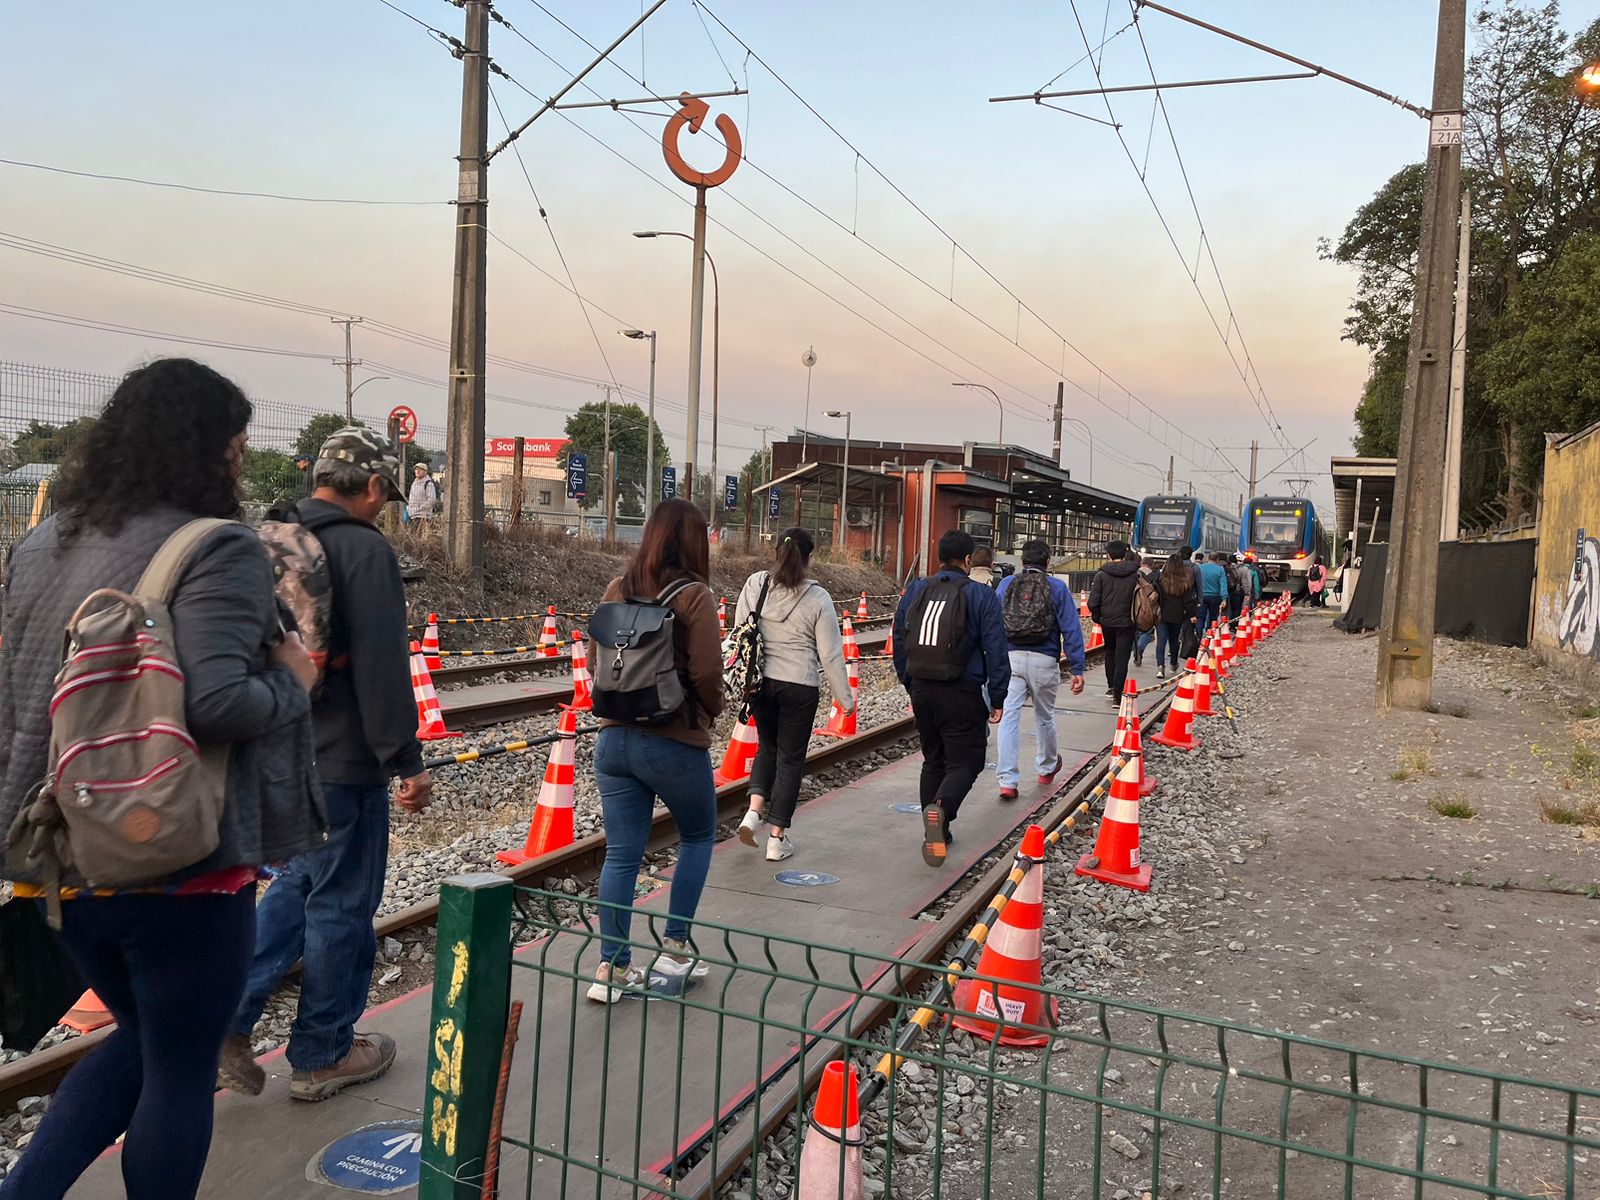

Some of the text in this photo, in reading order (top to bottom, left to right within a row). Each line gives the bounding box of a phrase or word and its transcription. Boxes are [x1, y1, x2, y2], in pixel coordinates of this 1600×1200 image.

[1443, 116, 1450, 127] 3
[1438, 131, 1461, 143] 21A
[496, 441, 551, 452] Scobank
[1004, 1002, 1022, 1011] HEAVY
[346, 1154, 407, 1175] CAMINA CON
[336, 1160, 399, 1182] PRECAUCIÓN
